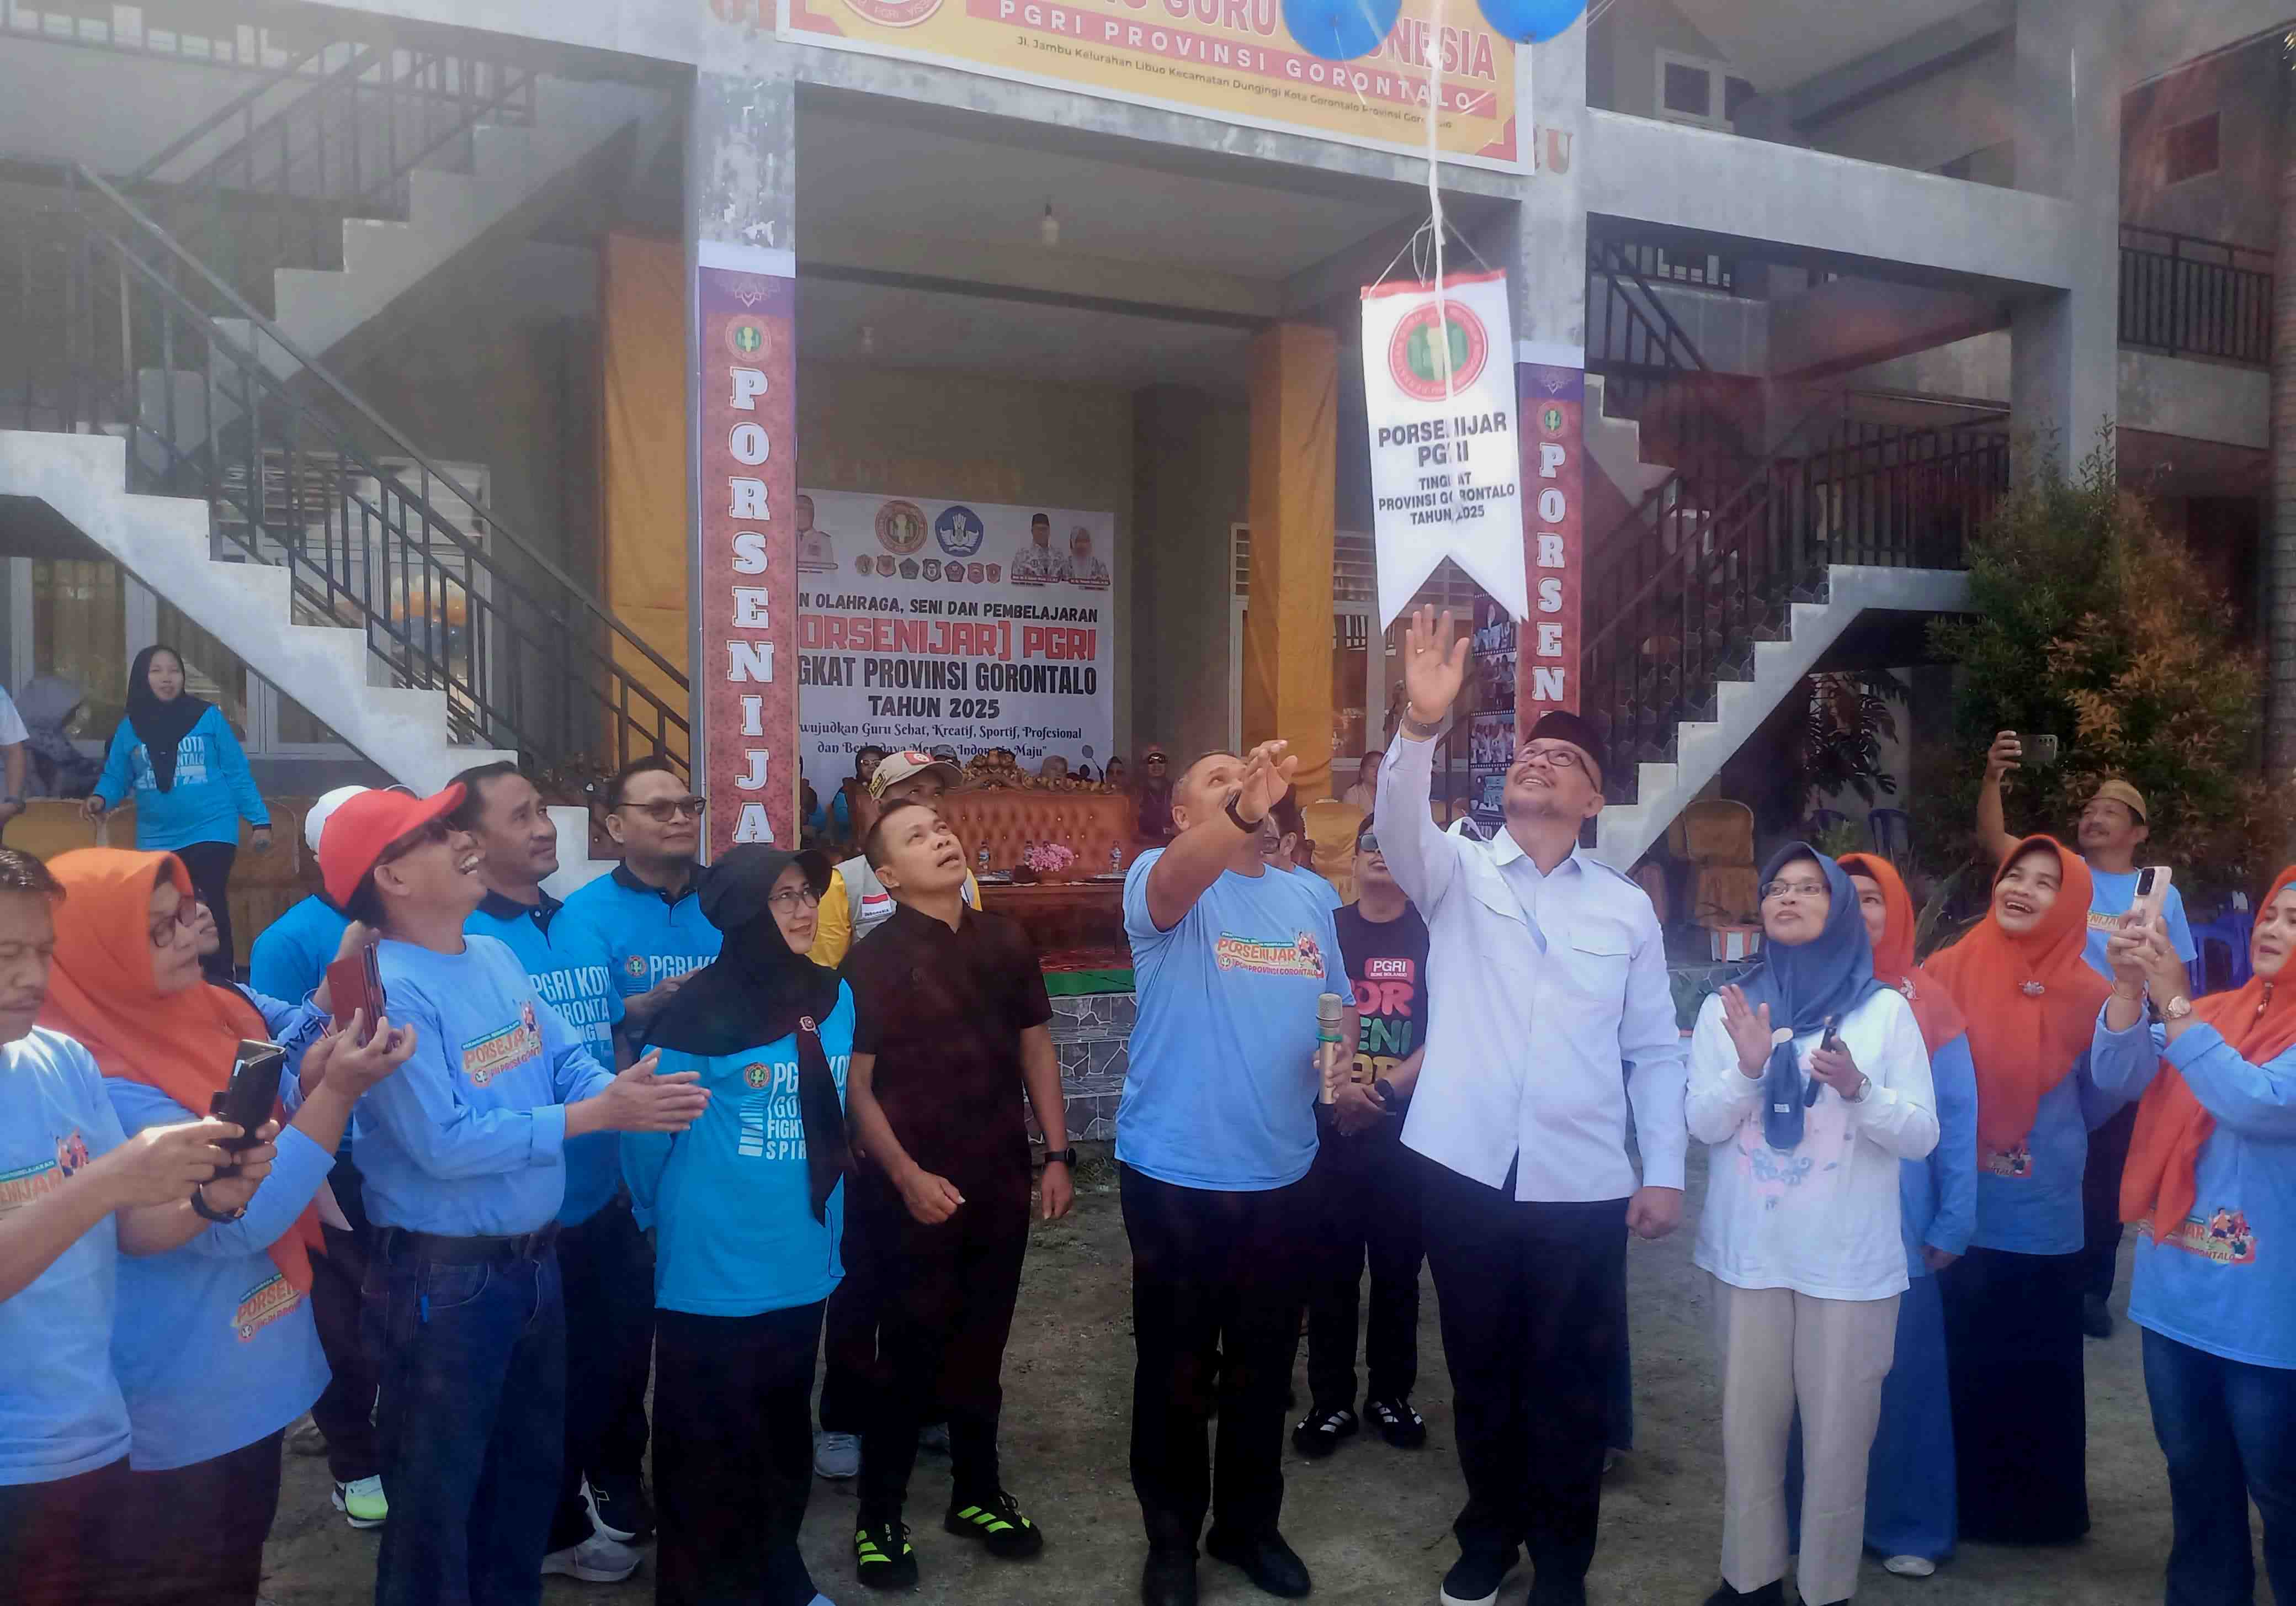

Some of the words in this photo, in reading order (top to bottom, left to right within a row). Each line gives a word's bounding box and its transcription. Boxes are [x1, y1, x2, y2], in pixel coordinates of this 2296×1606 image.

[1000, 1, 1082, 33] PGRI
[1104, 22, 1264, 71] PROVINSI
[1285, 59, 1471, 109] GORONTALO
[1033, 39, 1072, 56] Jambu
[1075, 48, 1132, 67] Kelurahan
[1169, 66, 1230, 87] Kecamatan
[1284, 89, 1308, 102] Kota
[1310, 94, 1360, 112] Gorontalo
[1378, 492, 1436, 511] PROVINSI
[1410, 508, 1452, 525] TAHUN
[1532, 443, 1565, 718] PORSEN
[815, 593, 904, 614] OLAHRAGA,
[909, 598, 943, 614] SENI
[947, 601, 978, 616] DAN
[983, 603, 1098, 623] PEMBELAJARAN
[1023, 625, 1096, 661] PGRI
[864, 658, 968, 691] PROVINSI
[975, 662, 1097, 696] GORONTALO
[868, 695, 941, 718] TAHUN
[949, 698, 1000, 719] 2025
[817, 741, 839, 755] dan
[861, 722, 891, 737] Guru
[979, 725, 1020, 740] Sportif,
[1022, 726, 1082, 741] Profesional
[1373, 960, 1406, 972] PGRI
[529, 967, 575, 1003] PGRI
[1352, 980, 1413, 1016] OR
